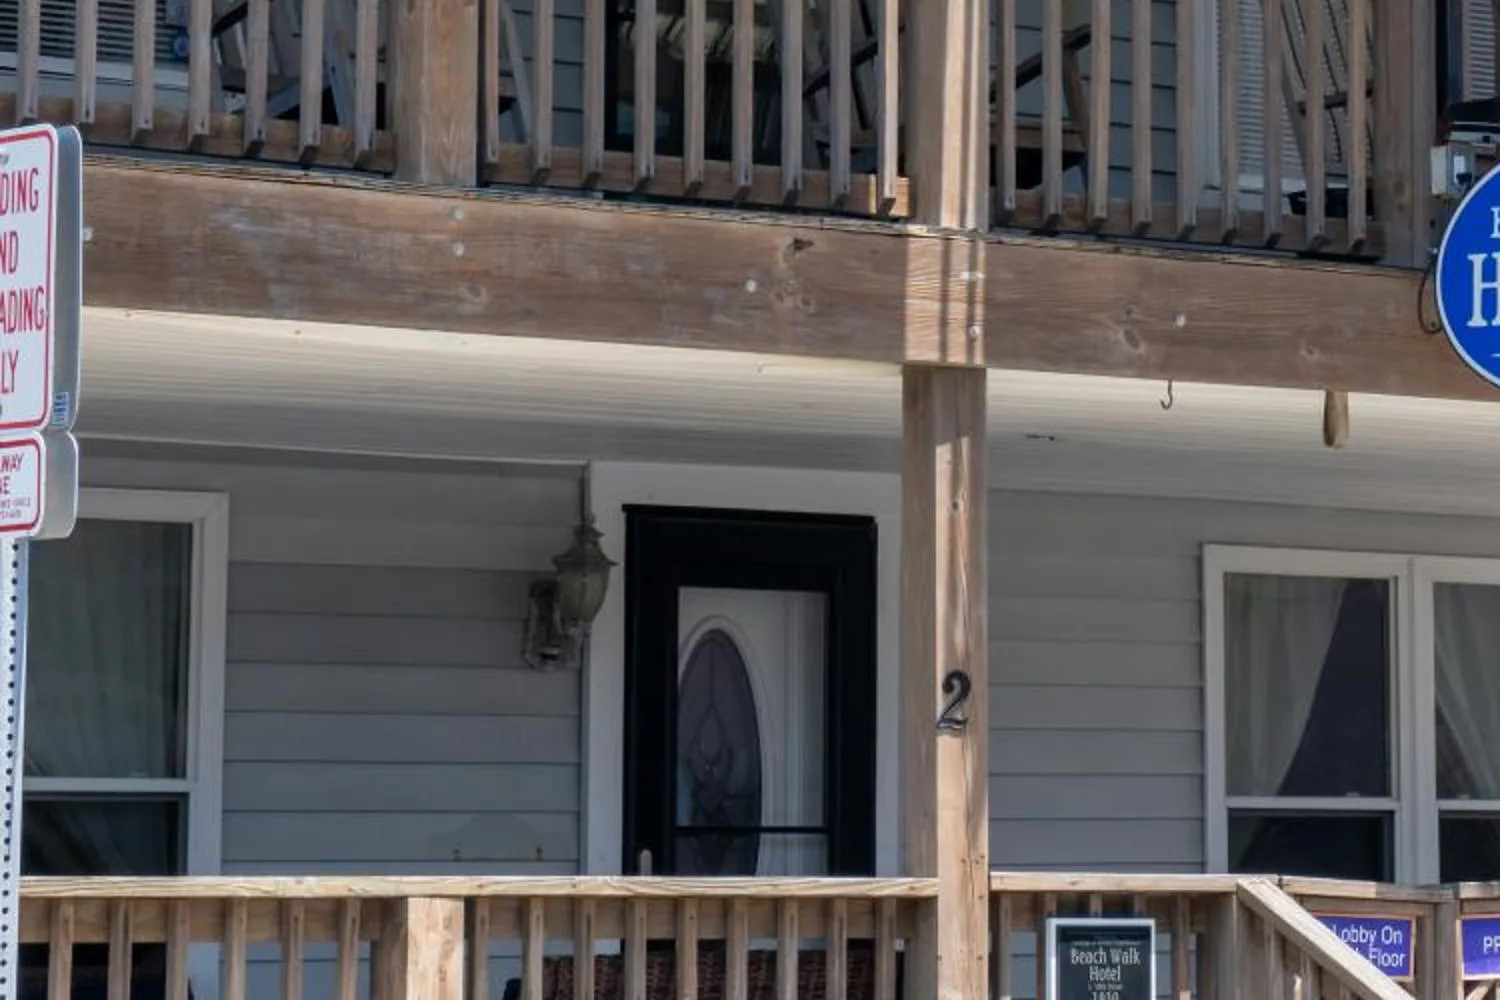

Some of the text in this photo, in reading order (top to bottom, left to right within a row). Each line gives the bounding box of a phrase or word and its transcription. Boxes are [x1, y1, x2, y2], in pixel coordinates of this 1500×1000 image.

[936, 669, 971, 730] 2
[1381, 925, 1403, 945] On
[1071, 947, 1141, 965] Beach Walk
[1368, 946, 1406, 968] Floor
[1089, 964, 1121, 981] Hotel
